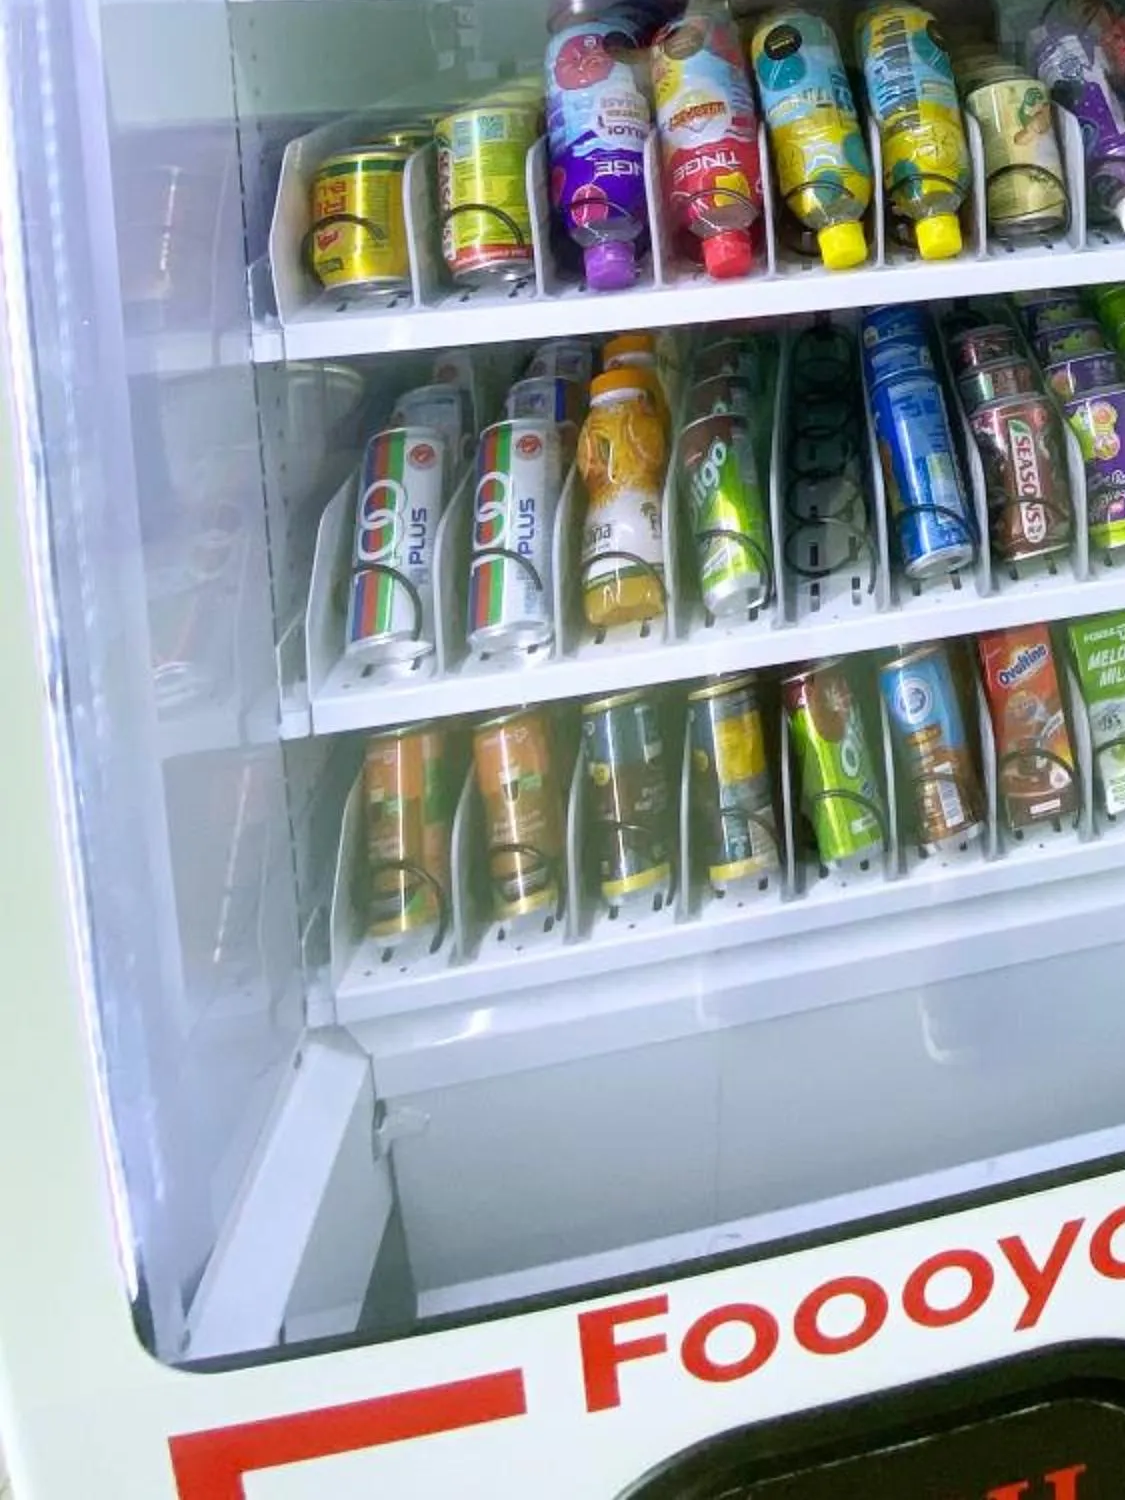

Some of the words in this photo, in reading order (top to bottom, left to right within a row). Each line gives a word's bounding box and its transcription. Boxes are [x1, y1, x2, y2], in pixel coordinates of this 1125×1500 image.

[408, 507, 428, 567] PLUS
[517, 497, 536, 556] PLUS
[999, 644, 1047, 685] Ovaltine
